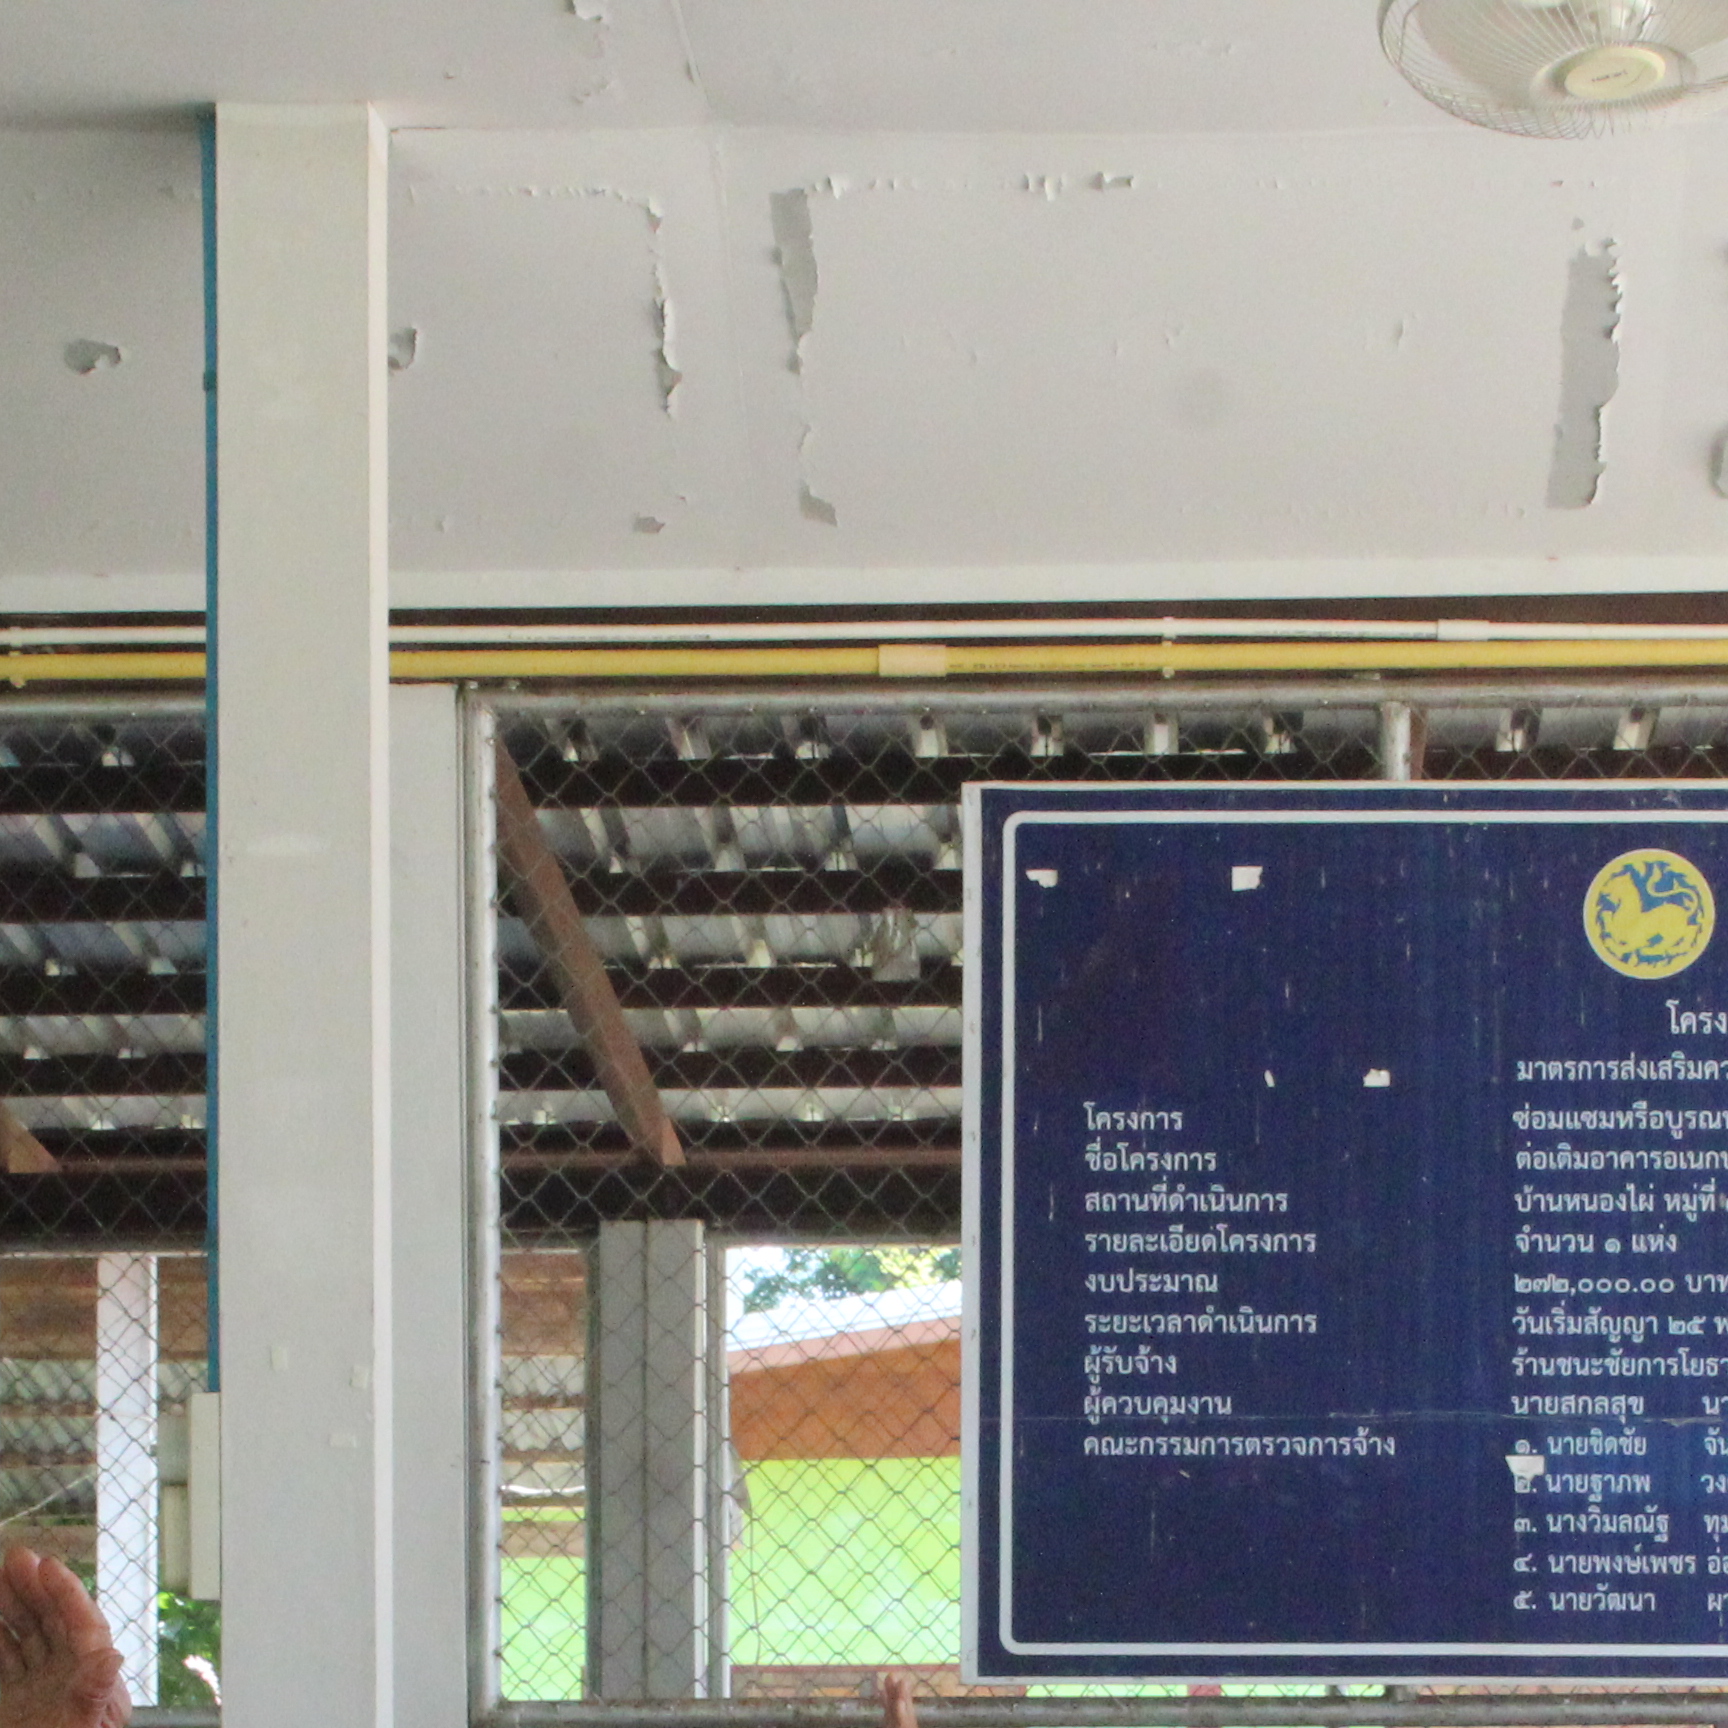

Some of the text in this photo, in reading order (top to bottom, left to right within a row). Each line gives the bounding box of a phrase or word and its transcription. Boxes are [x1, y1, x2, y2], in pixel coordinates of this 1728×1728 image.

[1083, 1100, 1183, 1131] โครงการ
[1084, 1135, 1217, 1172] ชื่อโครงการ
[1084, 1175, 1288, 1212] สถานที่ดำเนินการ
[1514, 1182, 1655, 1213] บ้านหนองไผ่
[1663, 1177, 1716, 1222] หมู่ที่
[1084, 1222, 1317, 1253] รายละเอียดโครงการ
[1515, 1223, 1678, 1254] จำนวน ๑ แห่ง
[1084, 1267, 1218, 1293] งบประมาณ
[1514, 1272, 1675, 1296] ๒๗๒,๐๐๐.๐๐
[1084, 1304, 1317, 1334] ระยะเวลาดำเนินการ
[1512, 1299, 1658, 1344] วันเริ่มสัญญา
[1667, 1315, 1707, 1335] ๒๕
[1084, 1344, 1177, 1385] ผู้รับจ้าง
[1083, 1385, 1232, 1425] ผู้ควบคุมงาน
[1511, 1394, 1645, 1425] นายสกลสุข
[1083, 1426, 1396, 1456] คณะกรรมการตรวจการจ้าง
[1549, 1583, 1656, 1612] นายวัฒนา
